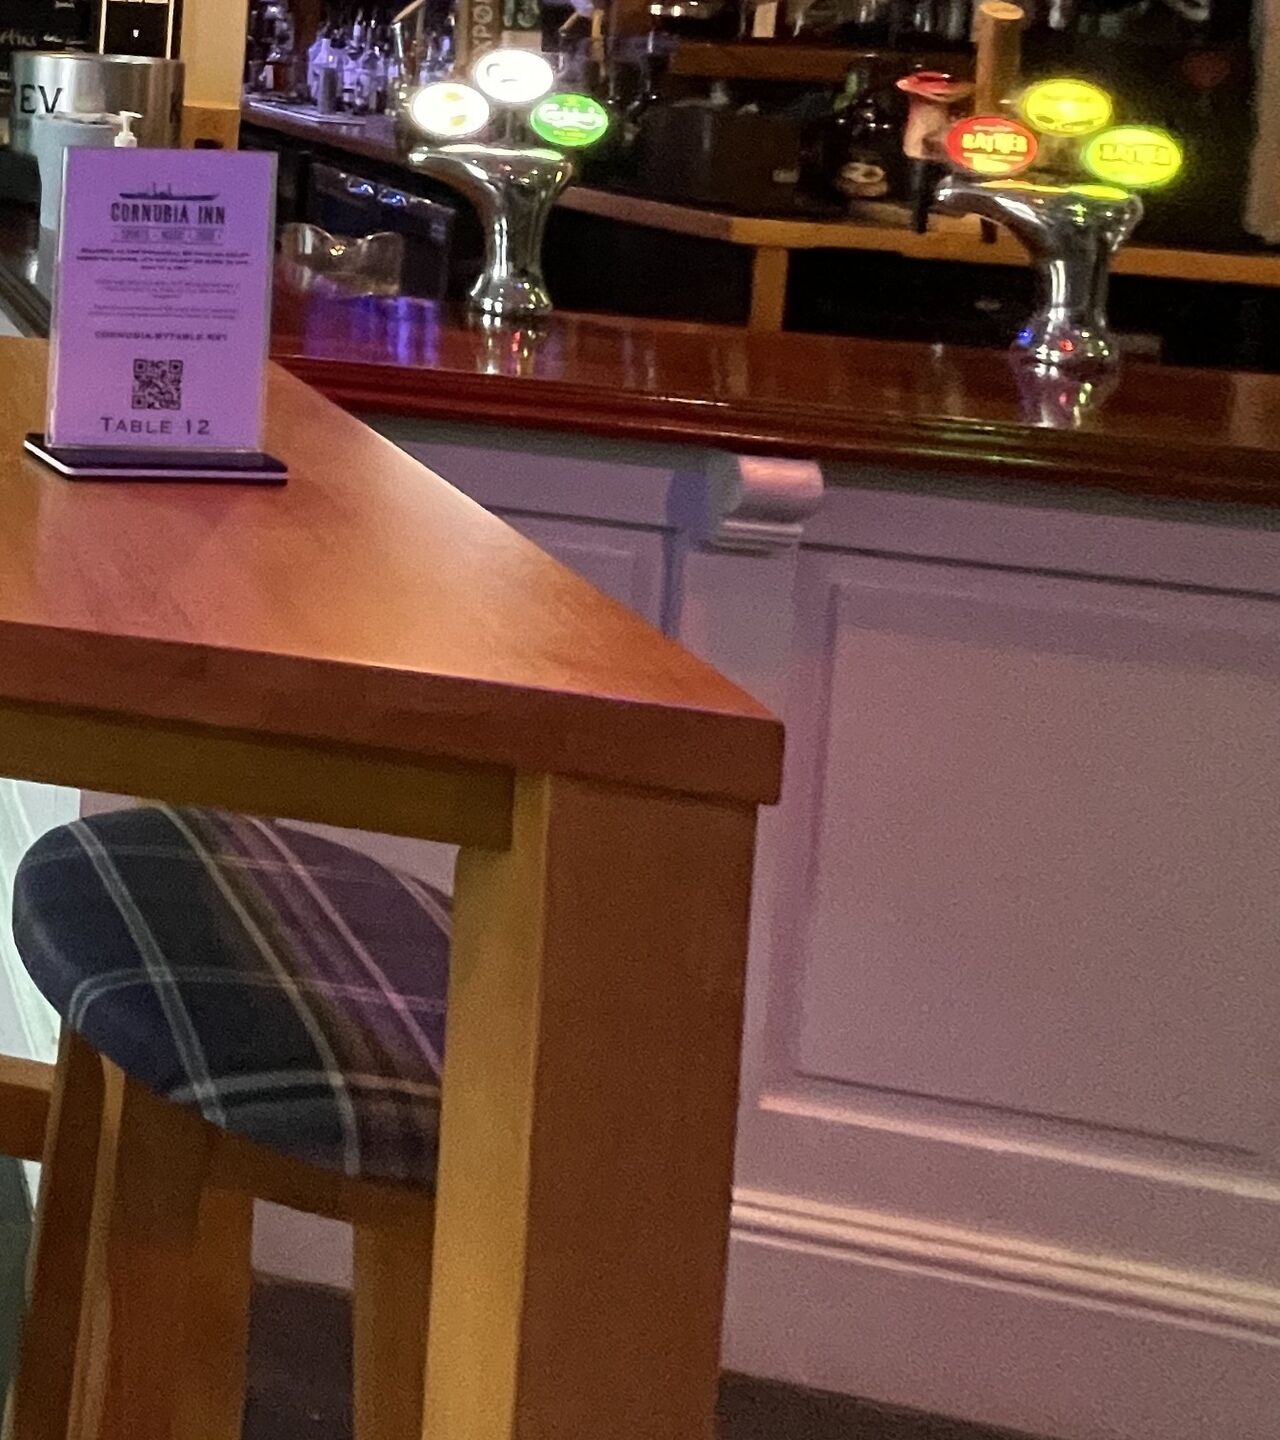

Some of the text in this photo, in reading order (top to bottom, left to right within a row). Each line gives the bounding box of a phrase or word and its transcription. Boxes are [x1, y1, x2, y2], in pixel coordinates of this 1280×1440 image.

[111, 202, 226, 225] CORNUBIA INN
[100, 416, 210, 435] TABLE 12
